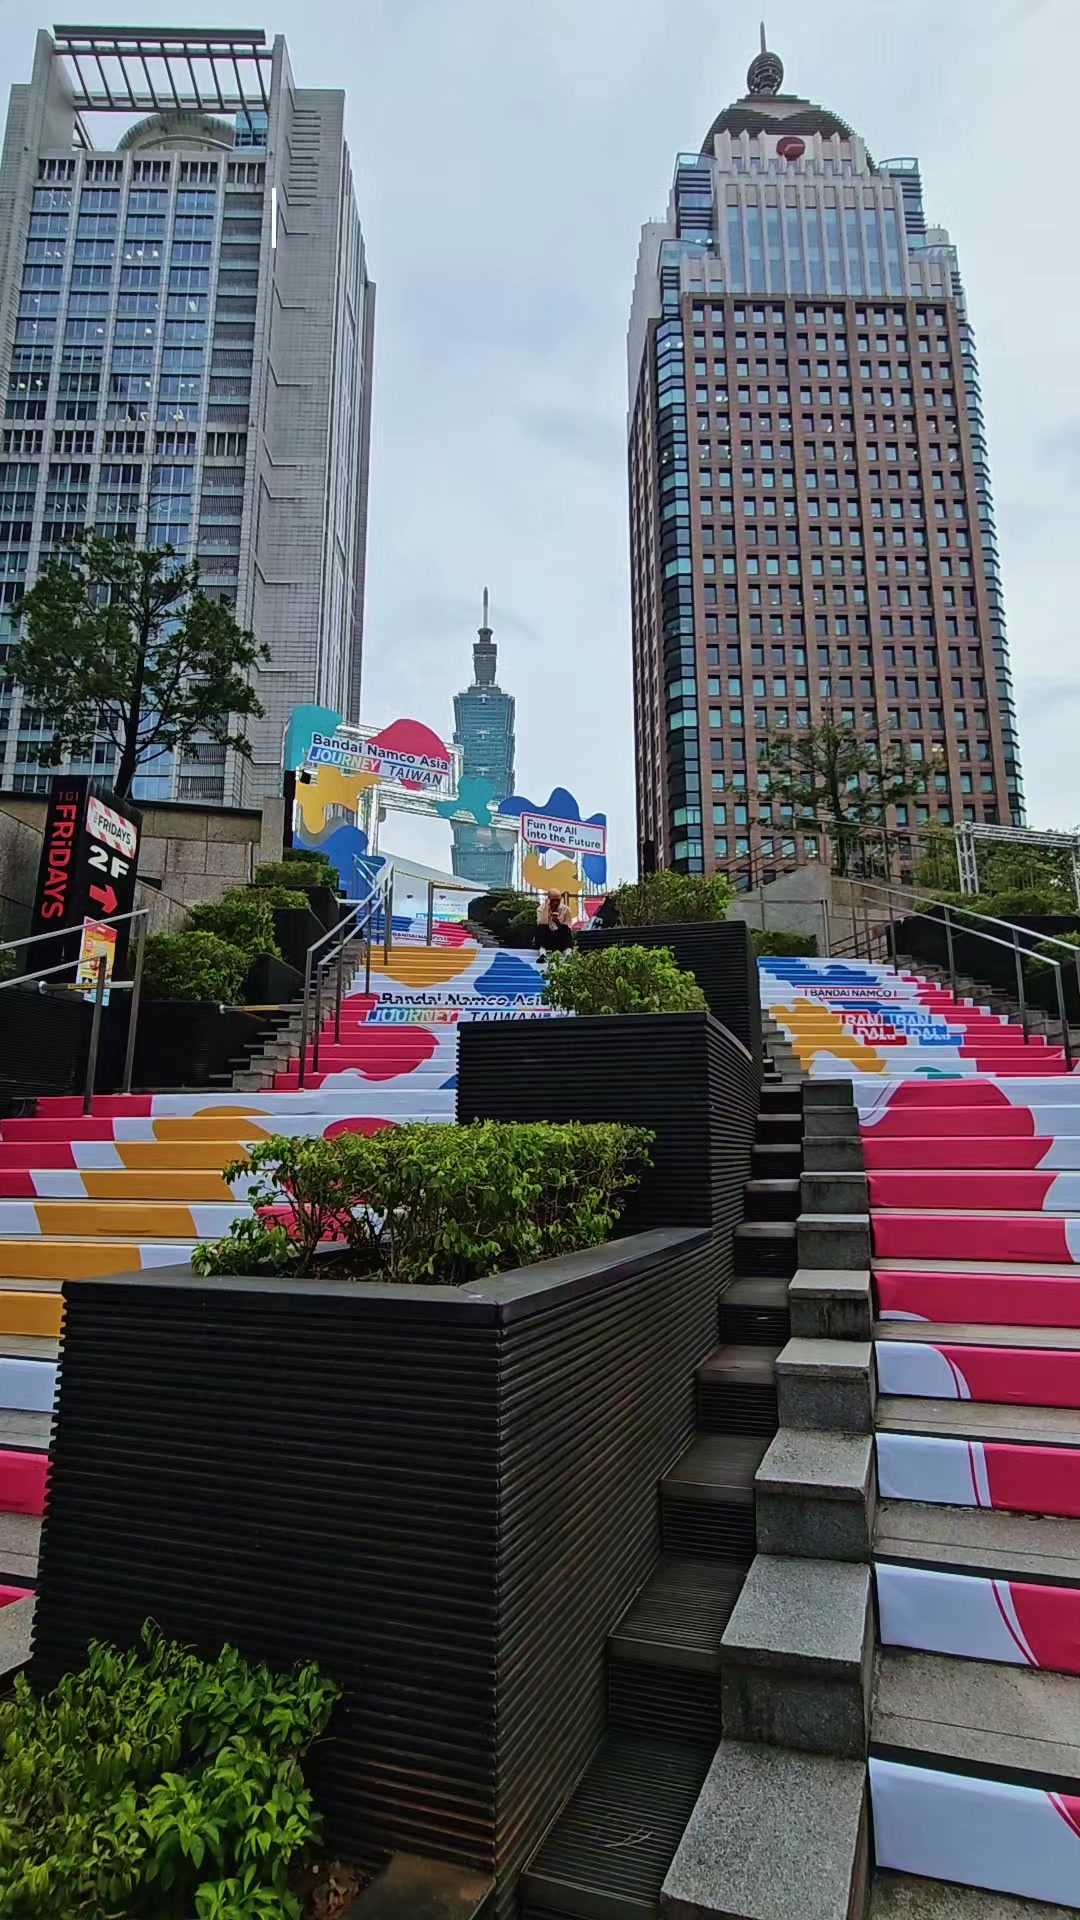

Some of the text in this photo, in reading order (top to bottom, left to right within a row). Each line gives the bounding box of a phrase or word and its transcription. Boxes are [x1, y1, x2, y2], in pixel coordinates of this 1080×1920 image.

[313, 734, 448, 770] Bandai Namco Asia
[311, 748, 443, 785] JOURNEY TAIWAN
[98, 815, 131, 844] FRIDAYS
[527, 819, 577, 835] Fun for All
[527, 829, 601, 849] into the Future
[88, 845, 130, 878] 2F
[379, 992, 442, 1006] Bandai
[446, 993, 507, 1006] Namco
[810, 989, 850, 997] BANDAI
[370, 1009, 458, 1022] JOURNEY
